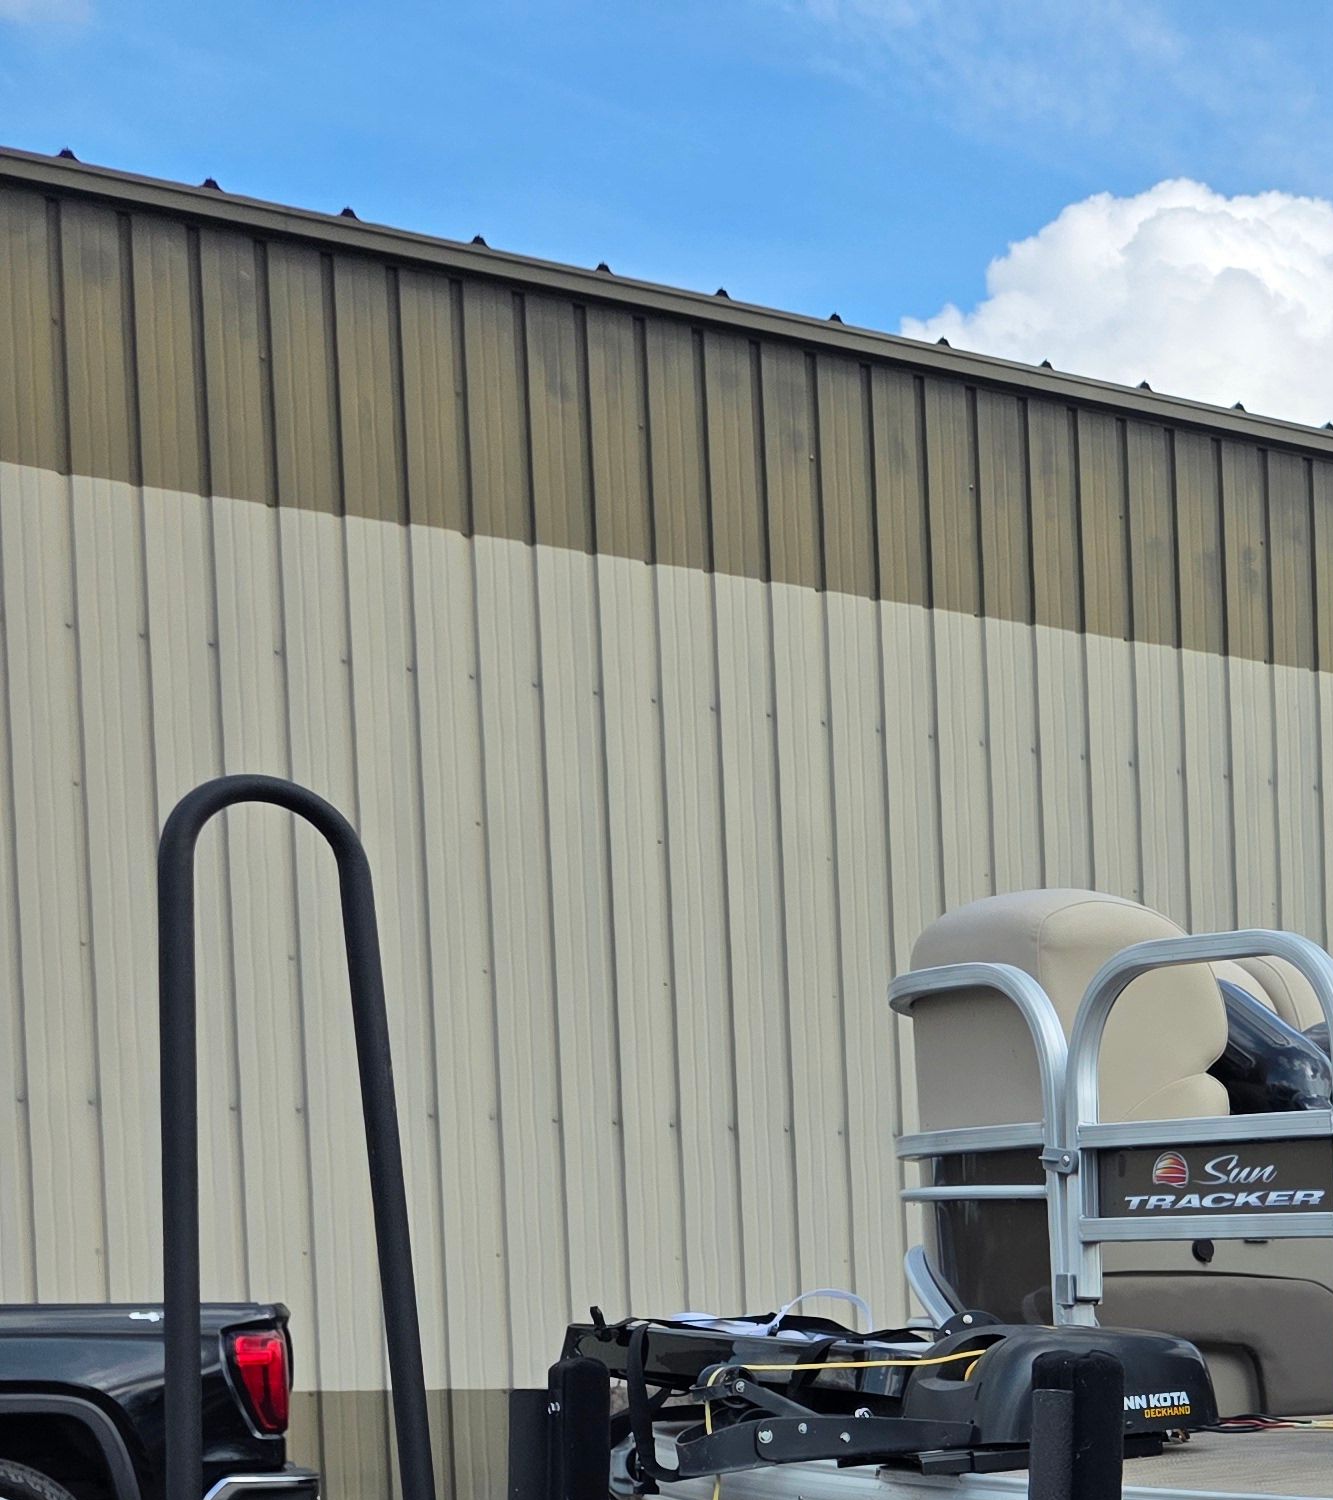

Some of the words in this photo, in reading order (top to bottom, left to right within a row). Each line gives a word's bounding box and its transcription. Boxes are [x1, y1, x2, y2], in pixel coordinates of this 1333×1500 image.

[1194, 1154, 1278, 1186] Sun
[1124, 1189, 1326, 1210] TRACKER
[1123, 1395, 1148, 1411] NN
[1148, 1391, 1190, 1408] KOTA
[1144, 1405, 1191, 1418] DECKHAND
